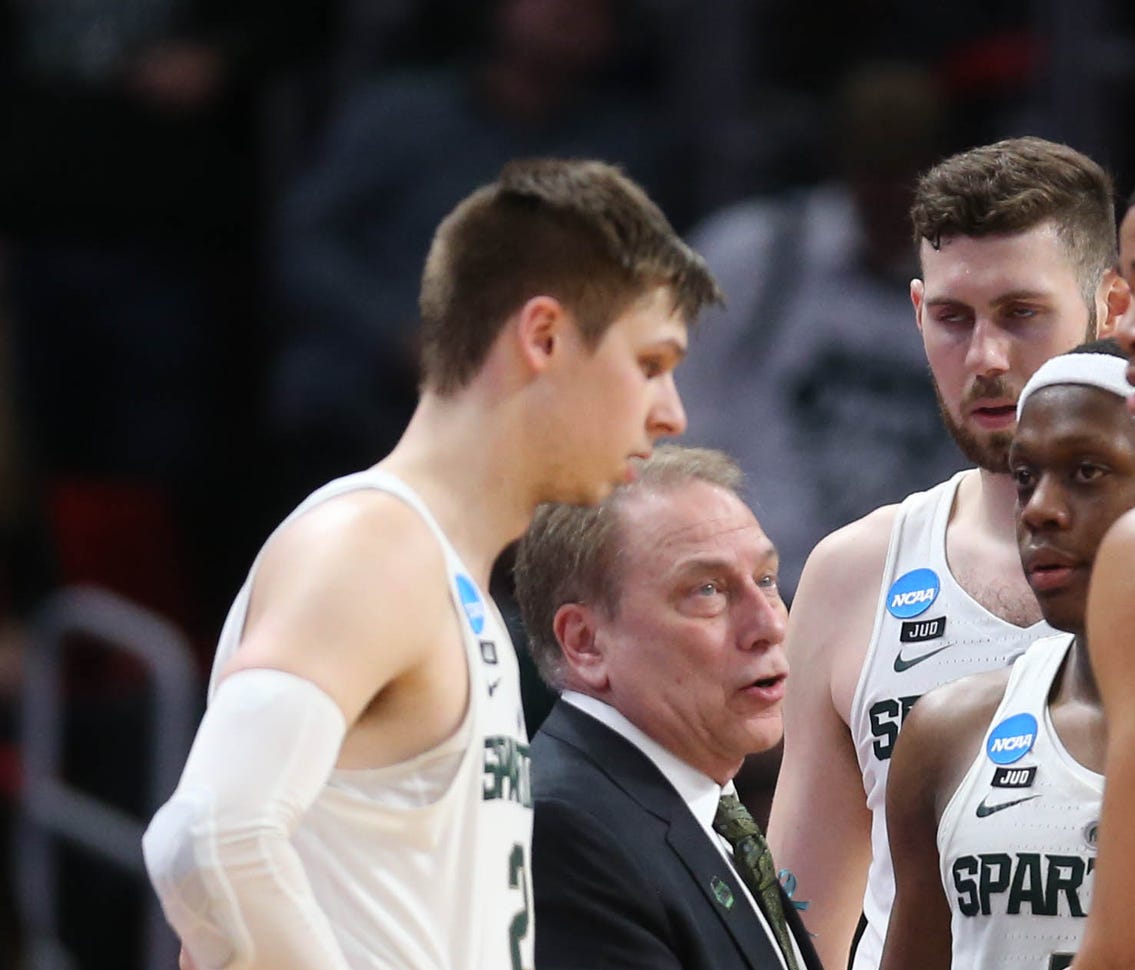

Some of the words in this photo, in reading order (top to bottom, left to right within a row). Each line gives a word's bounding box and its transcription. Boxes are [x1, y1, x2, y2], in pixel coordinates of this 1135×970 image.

[891, 588, 936, 608] NCAA
[909, 621, 939, 639] JUD
[990, 733, 1034, 753] NCAA
[999, 769, 1030, 785] JUD
[952, 852, 1098, 918] SPAR
